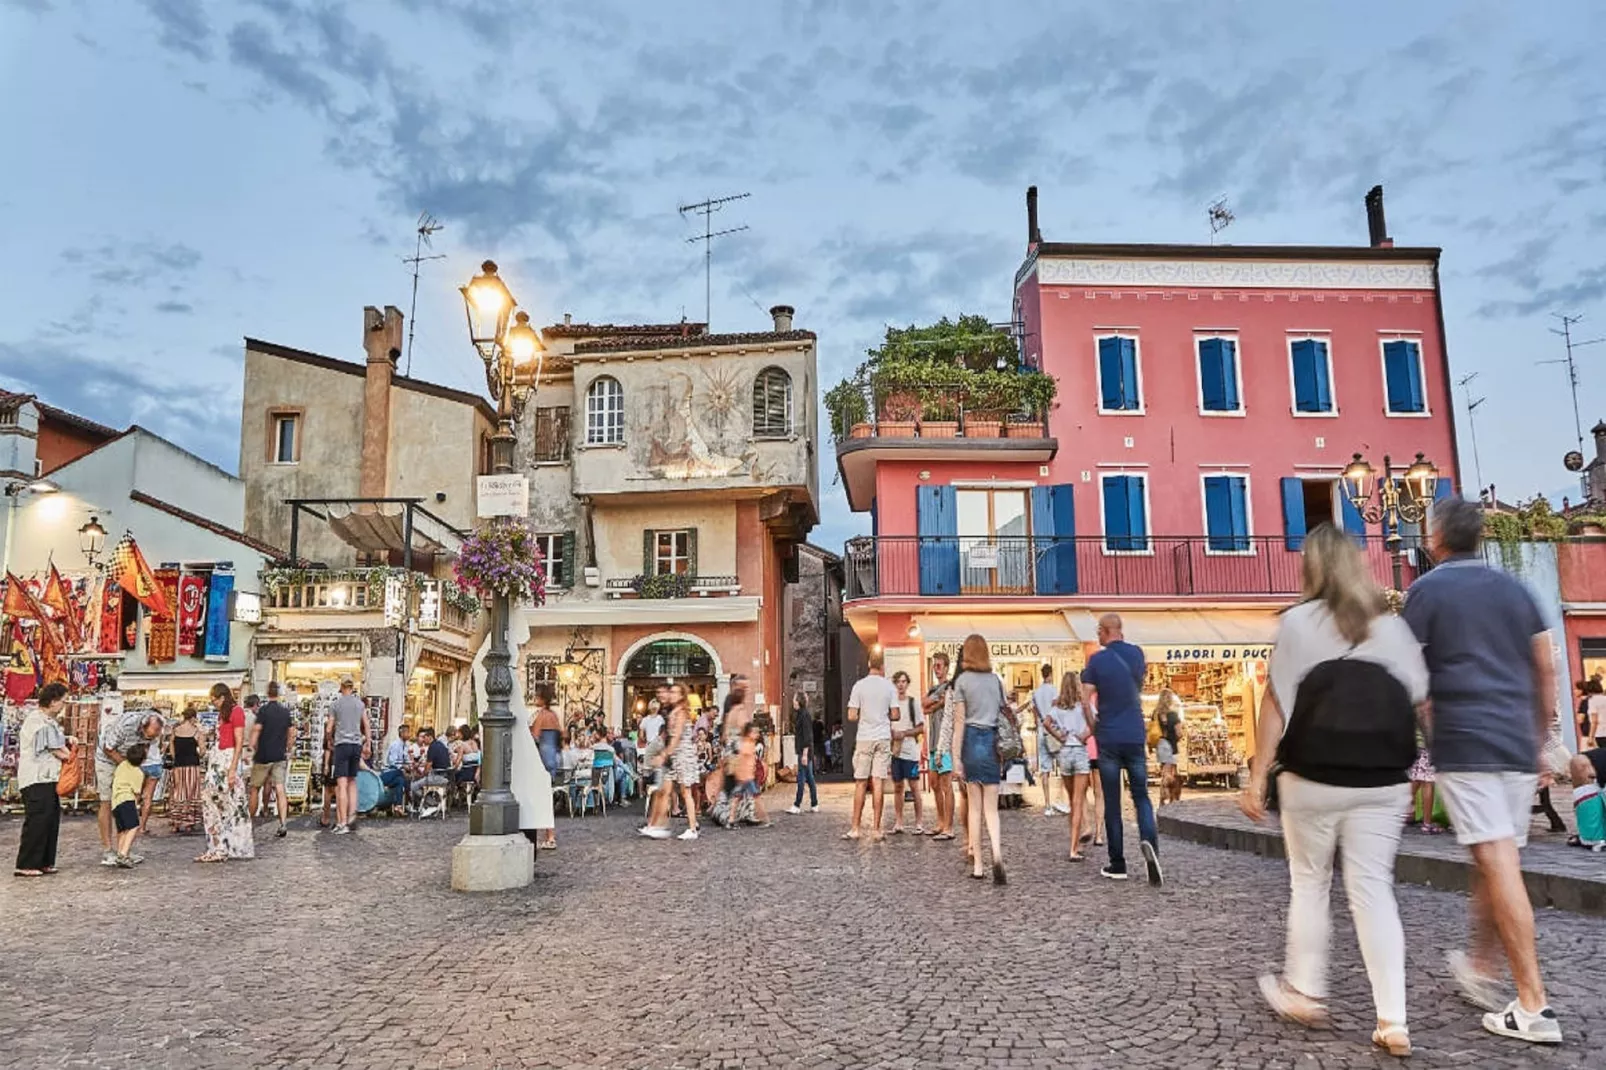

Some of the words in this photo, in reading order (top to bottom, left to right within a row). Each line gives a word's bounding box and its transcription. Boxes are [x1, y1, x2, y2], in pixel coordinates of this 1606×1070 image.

[991, 644, 1040, 656] GELATO
[1166, 648, 1215, 660] SAPORI
[1222, 648, 1237, 659] DI
